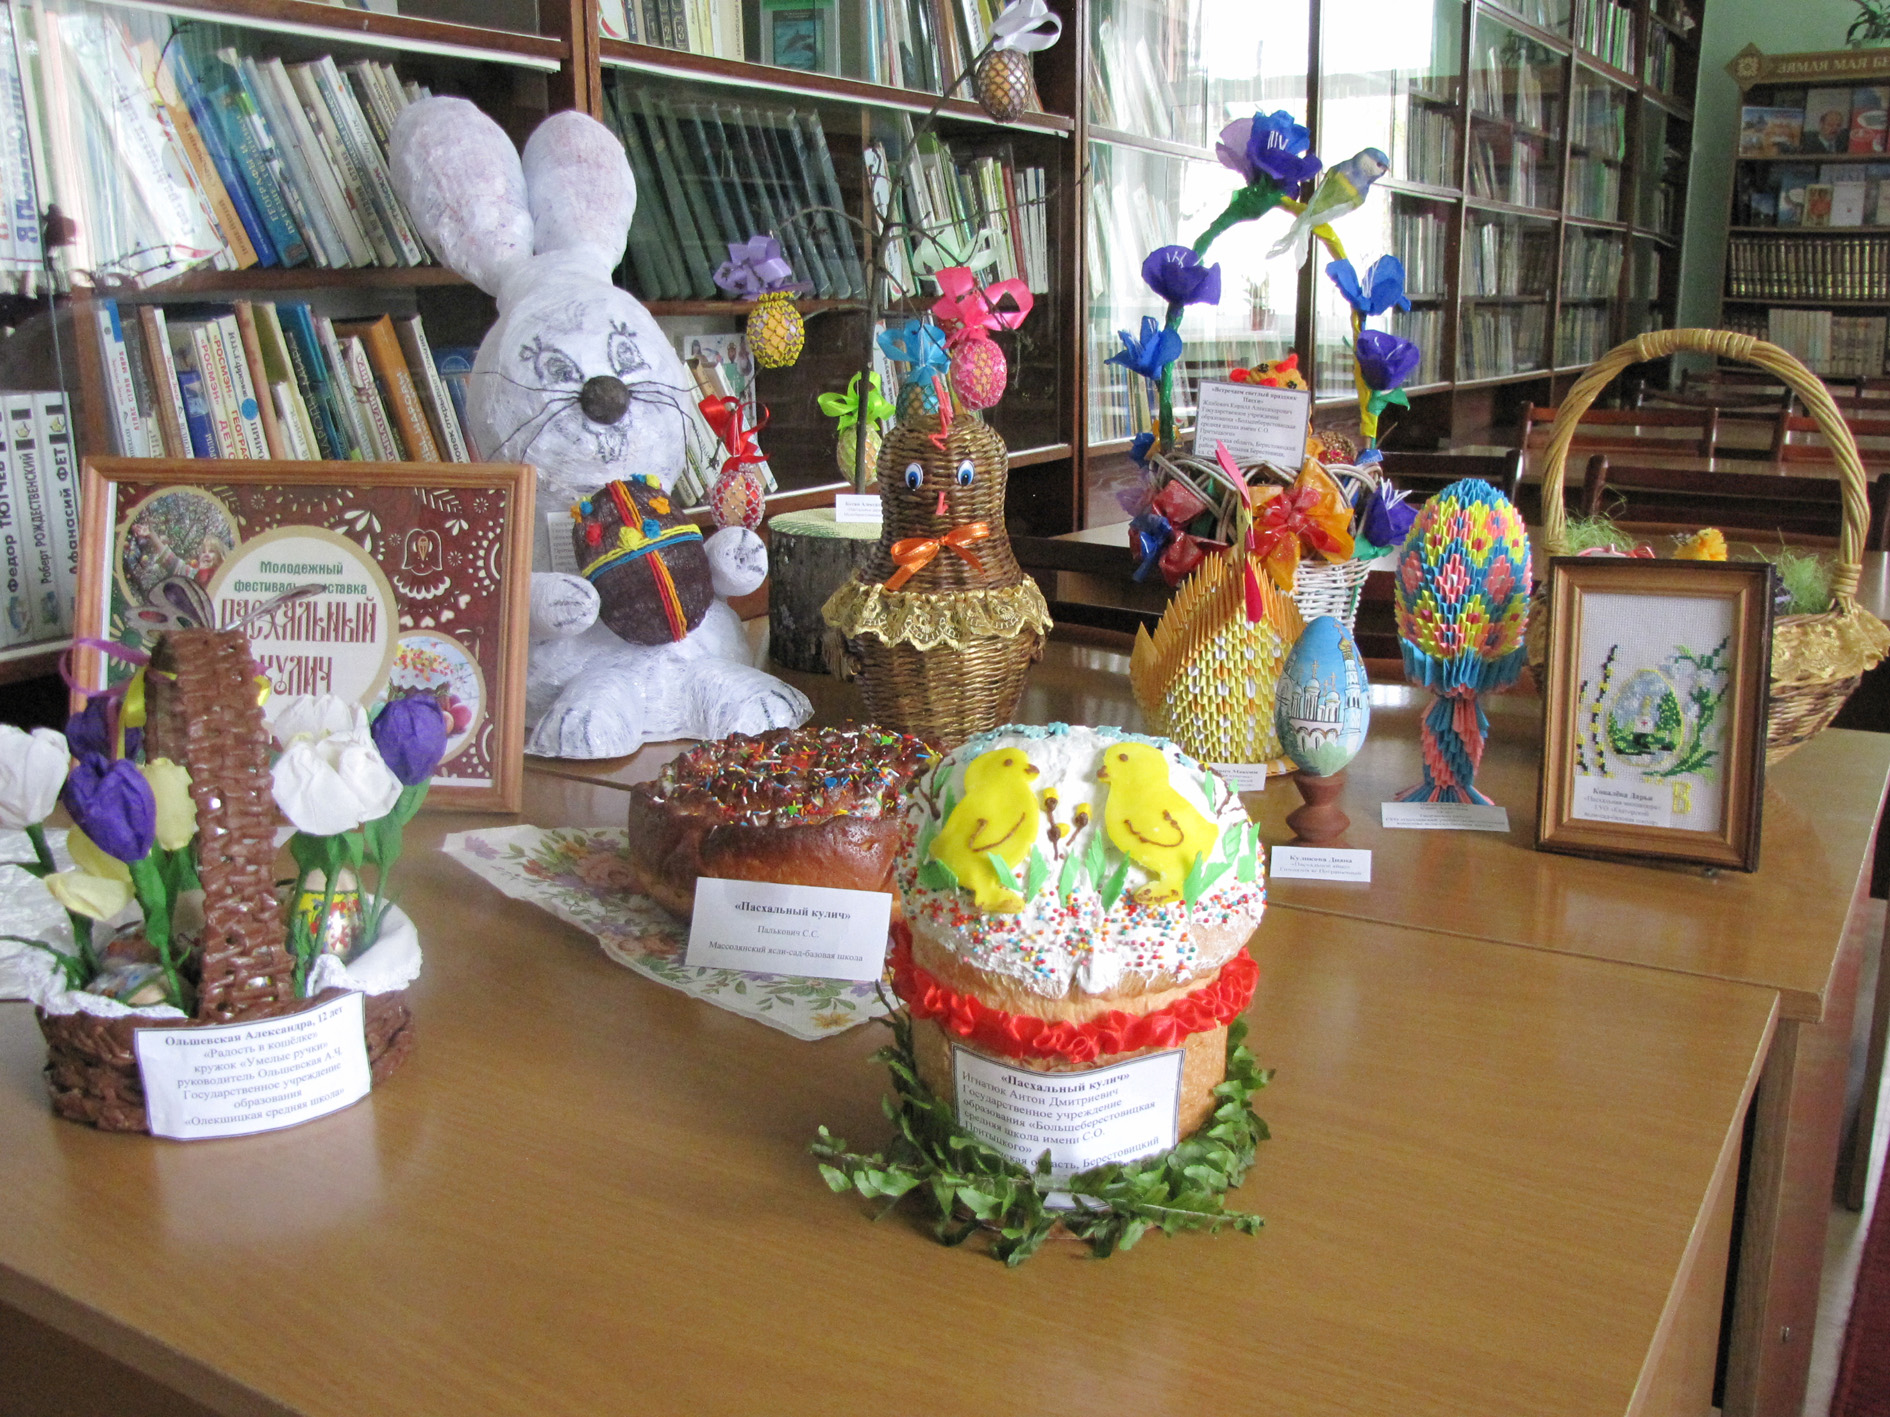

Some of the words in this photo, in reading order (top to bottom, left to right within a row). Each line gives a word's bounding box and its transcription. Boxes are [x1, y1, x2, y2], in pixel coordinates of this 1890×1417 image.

[245, 157, 279, 222] ГЕОГРАФЫ
[211, 334, 235, 398] «РОСМЭН»
[355, 353, 372, 388] МИРА
[53, 446, 69, 481] ФЕТ
[19, 452, 47, 547] РОЖДЕСТВЕНСКИЙ
[58, 487, 81, 575] Афанасий
[1, 533, 23, 593] Федор
[37, 549, 54, 584] Роберт
[260, 561, 344, 575] Молодежный
[734, 901, 809, 917] «Пасхальный
[812, 908, 851, 921] кулич»
[757, 925, 800, 937] Палькович
[802, 929, 819, 938] С.С.
[708, 941, 766, 954] Массолянский
[767, 948, 835, 960] ясли-сад-базовая
[837, 953, 863, 962] школа
[164, 1033, 241, 1047] Ольшевская
[245, 1019, 315, 1041] Александра,
[318, 1011, 328, 1023] 12
[329, 1005, 343, 1020] лет
[194, 1062, 236, 1075] кружок
[240, 1053, 291, 1068] «Умелые
[293, 1043, 328, 1061] ручки»
[203, 1046, 256, 1059] «Радость
[268, 1032, 318, 1050] кошёлке»
[176, 1074, 255, 1090] руководитель
[258, 1058, 322, 1078] Ольшевская
[183, 1081, 281, 1100] Государственное
[283, 1063, 342, 1090] учреждение
[962, 1071, 1006, 1096] Игнатюк
[1009, 1089, 1046, 1106] Антон
[1048, 1087, 1119, 1108] Дмитриевич
[1001, 1074, 1086, 1093] «Пасхальный
[1089, 1072, 1130, 1092] кулич»
[183, 1110, 263, 1127] «Олекшицкая
[265, 1101, 308, 1120] средняя
[310, 1087, 345, 1106] школа»
[233, 1089, 302, 1110] образования
[962, 1084, 1053, 1119] Государственное
[1056, 1099, 1122, 1122] учреждение
[963, 1099, 1025, 1128] образования
[1029, 1100, 1156, 1132] «Большеберестовицкая
[964, 1109, 1002, 1131] средняя
[1005, 1126, 1040, 1143] школа
[1043, 1135, 1080, 1145] имени
[1082, 1128, 1105, 1143] С.О.
[964, 1120, 1032, 1155] Притыцкого»
[1030, 1158, 1080, 1171] оасть,
[1083, 1136, 1160, 1169] Берестовицкий
